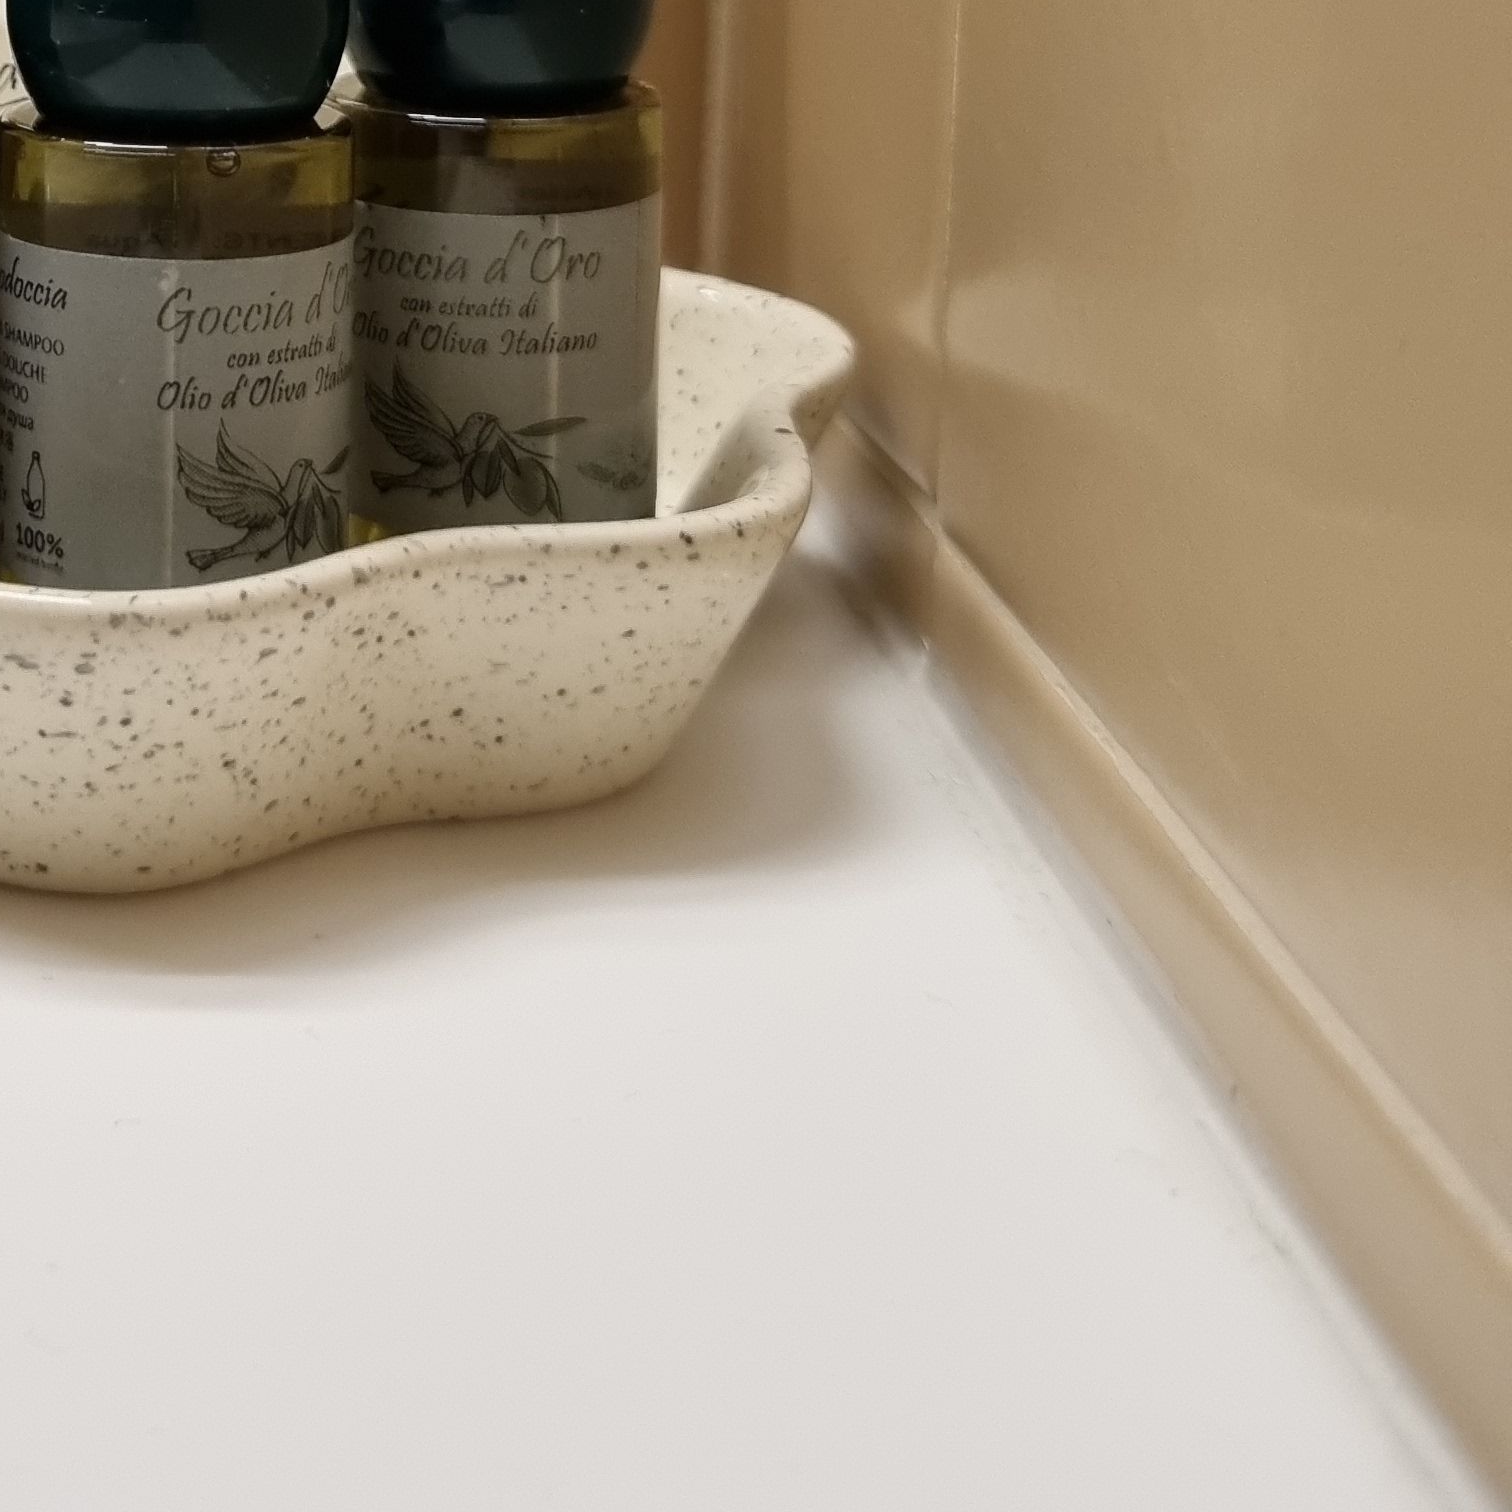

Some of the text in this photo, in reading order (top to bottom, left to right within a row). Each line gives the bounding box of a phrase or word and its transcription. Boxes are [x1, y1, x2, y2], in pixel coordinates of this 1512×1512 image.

[352, 225, 602, 285] Goccia d'Oro
[156, 286, 294, 345] Goccia
[399, 291, 540, 320] con estratti di
[226, 350, 261, 369] con
[266, 332, 323, 366] estratti
[352, 309, 599, 356] Olio d'Oliva Italiano
[156, 375, 212, 411] Olio
[220, 369, 307, 411] d'Oliva
[15, 521, 65, 559] 100%
